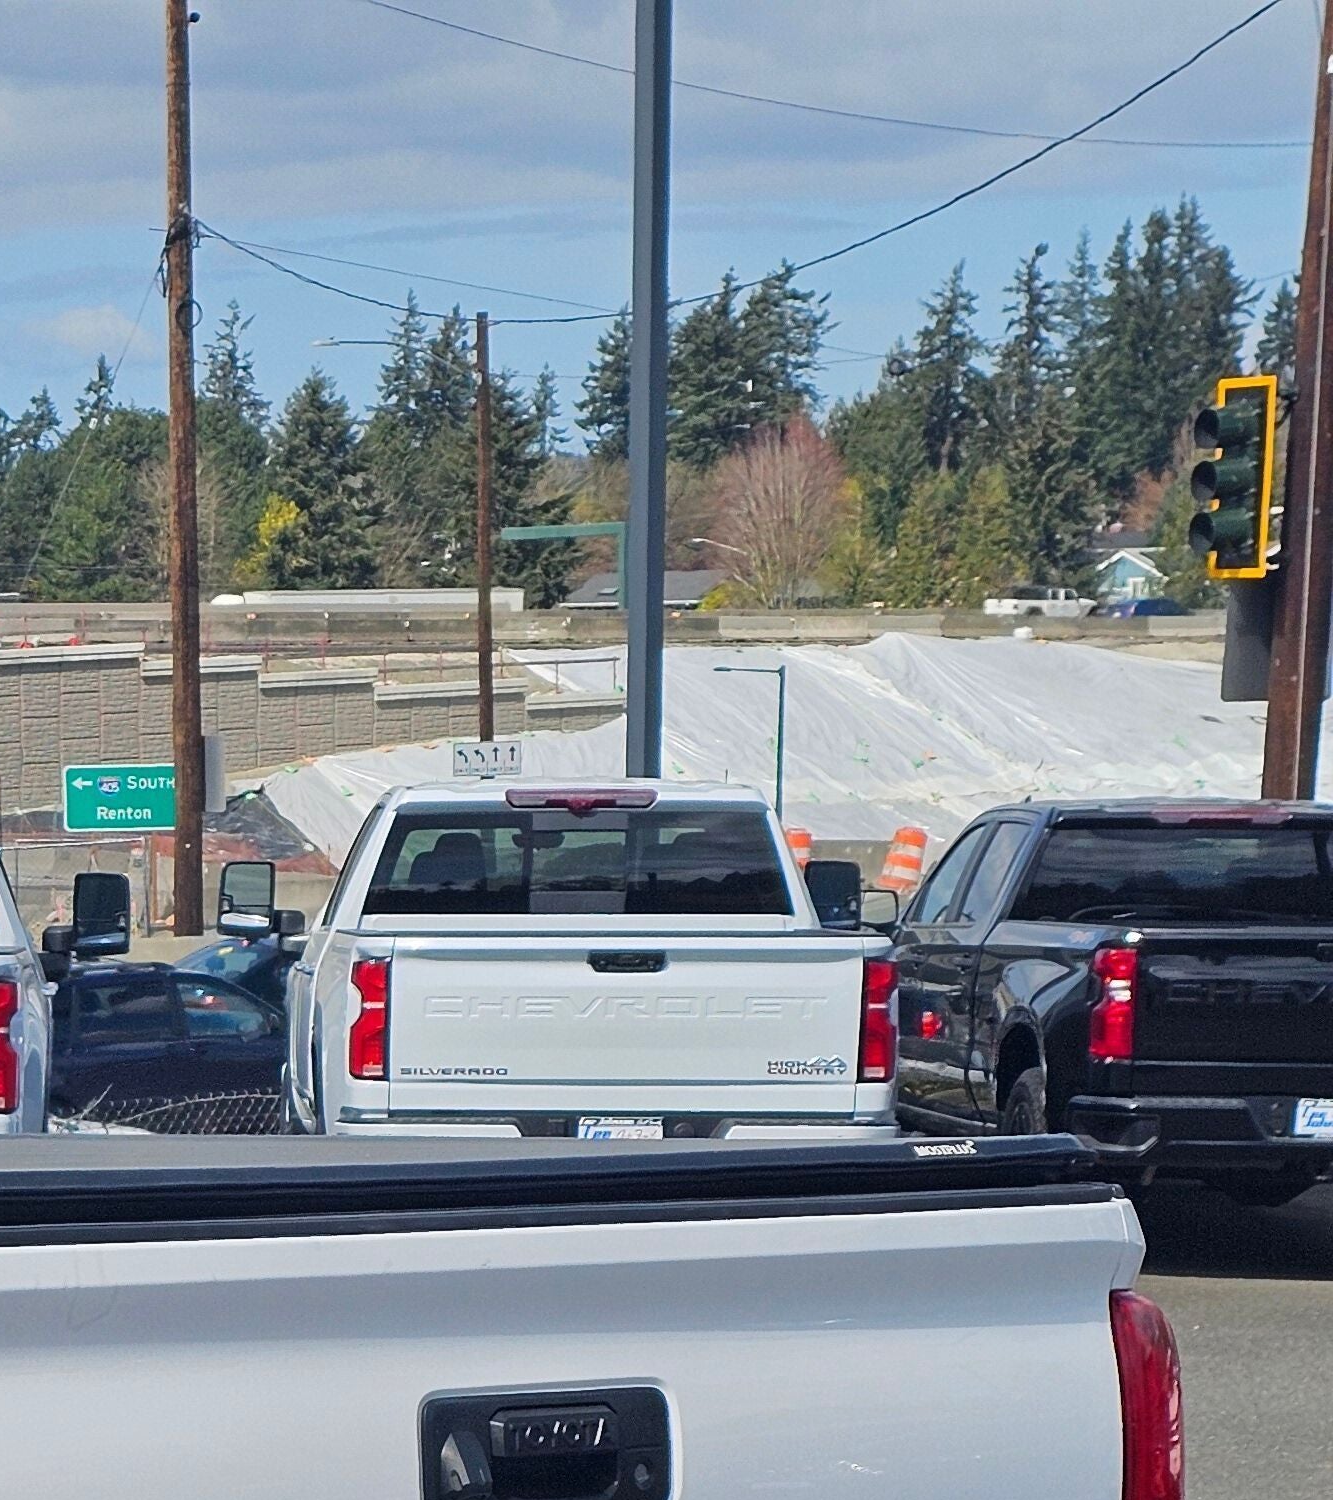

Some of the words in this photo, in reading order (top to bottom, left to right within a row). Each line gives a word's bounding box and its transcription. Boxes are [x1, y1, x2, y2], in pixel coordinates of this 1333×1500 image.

[97, 806, 152, 820] Renton
[425, 995, 828, 1019] CHEVROLET
[400, 1067, 508, 1076] SILVERADO
[767, 1067, 847, 1076] COUNTRY
